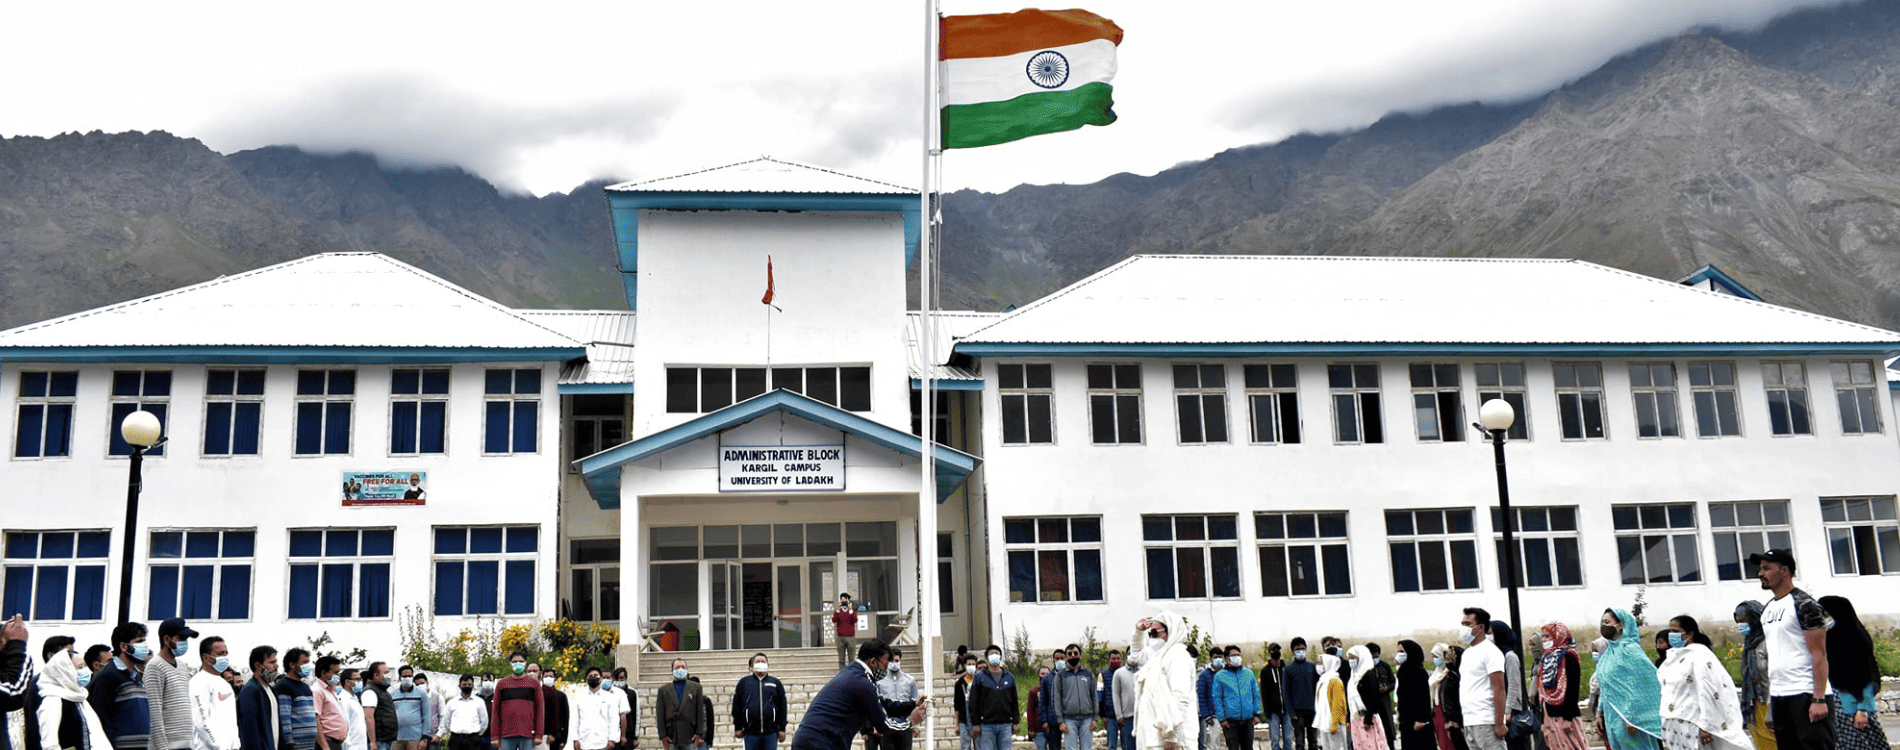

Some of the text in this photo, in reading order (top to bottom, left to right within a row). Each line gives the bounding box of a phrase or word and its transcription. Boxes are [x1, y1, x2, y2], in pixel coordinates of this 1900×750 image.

[724, 449, 840, 461] ADMINISTRATIVE BLOCK
[742, 463, 821, 472] KARGIL CAMPUS
[731, 476, 834, 485] UNIVERSITY OF LADAKH
